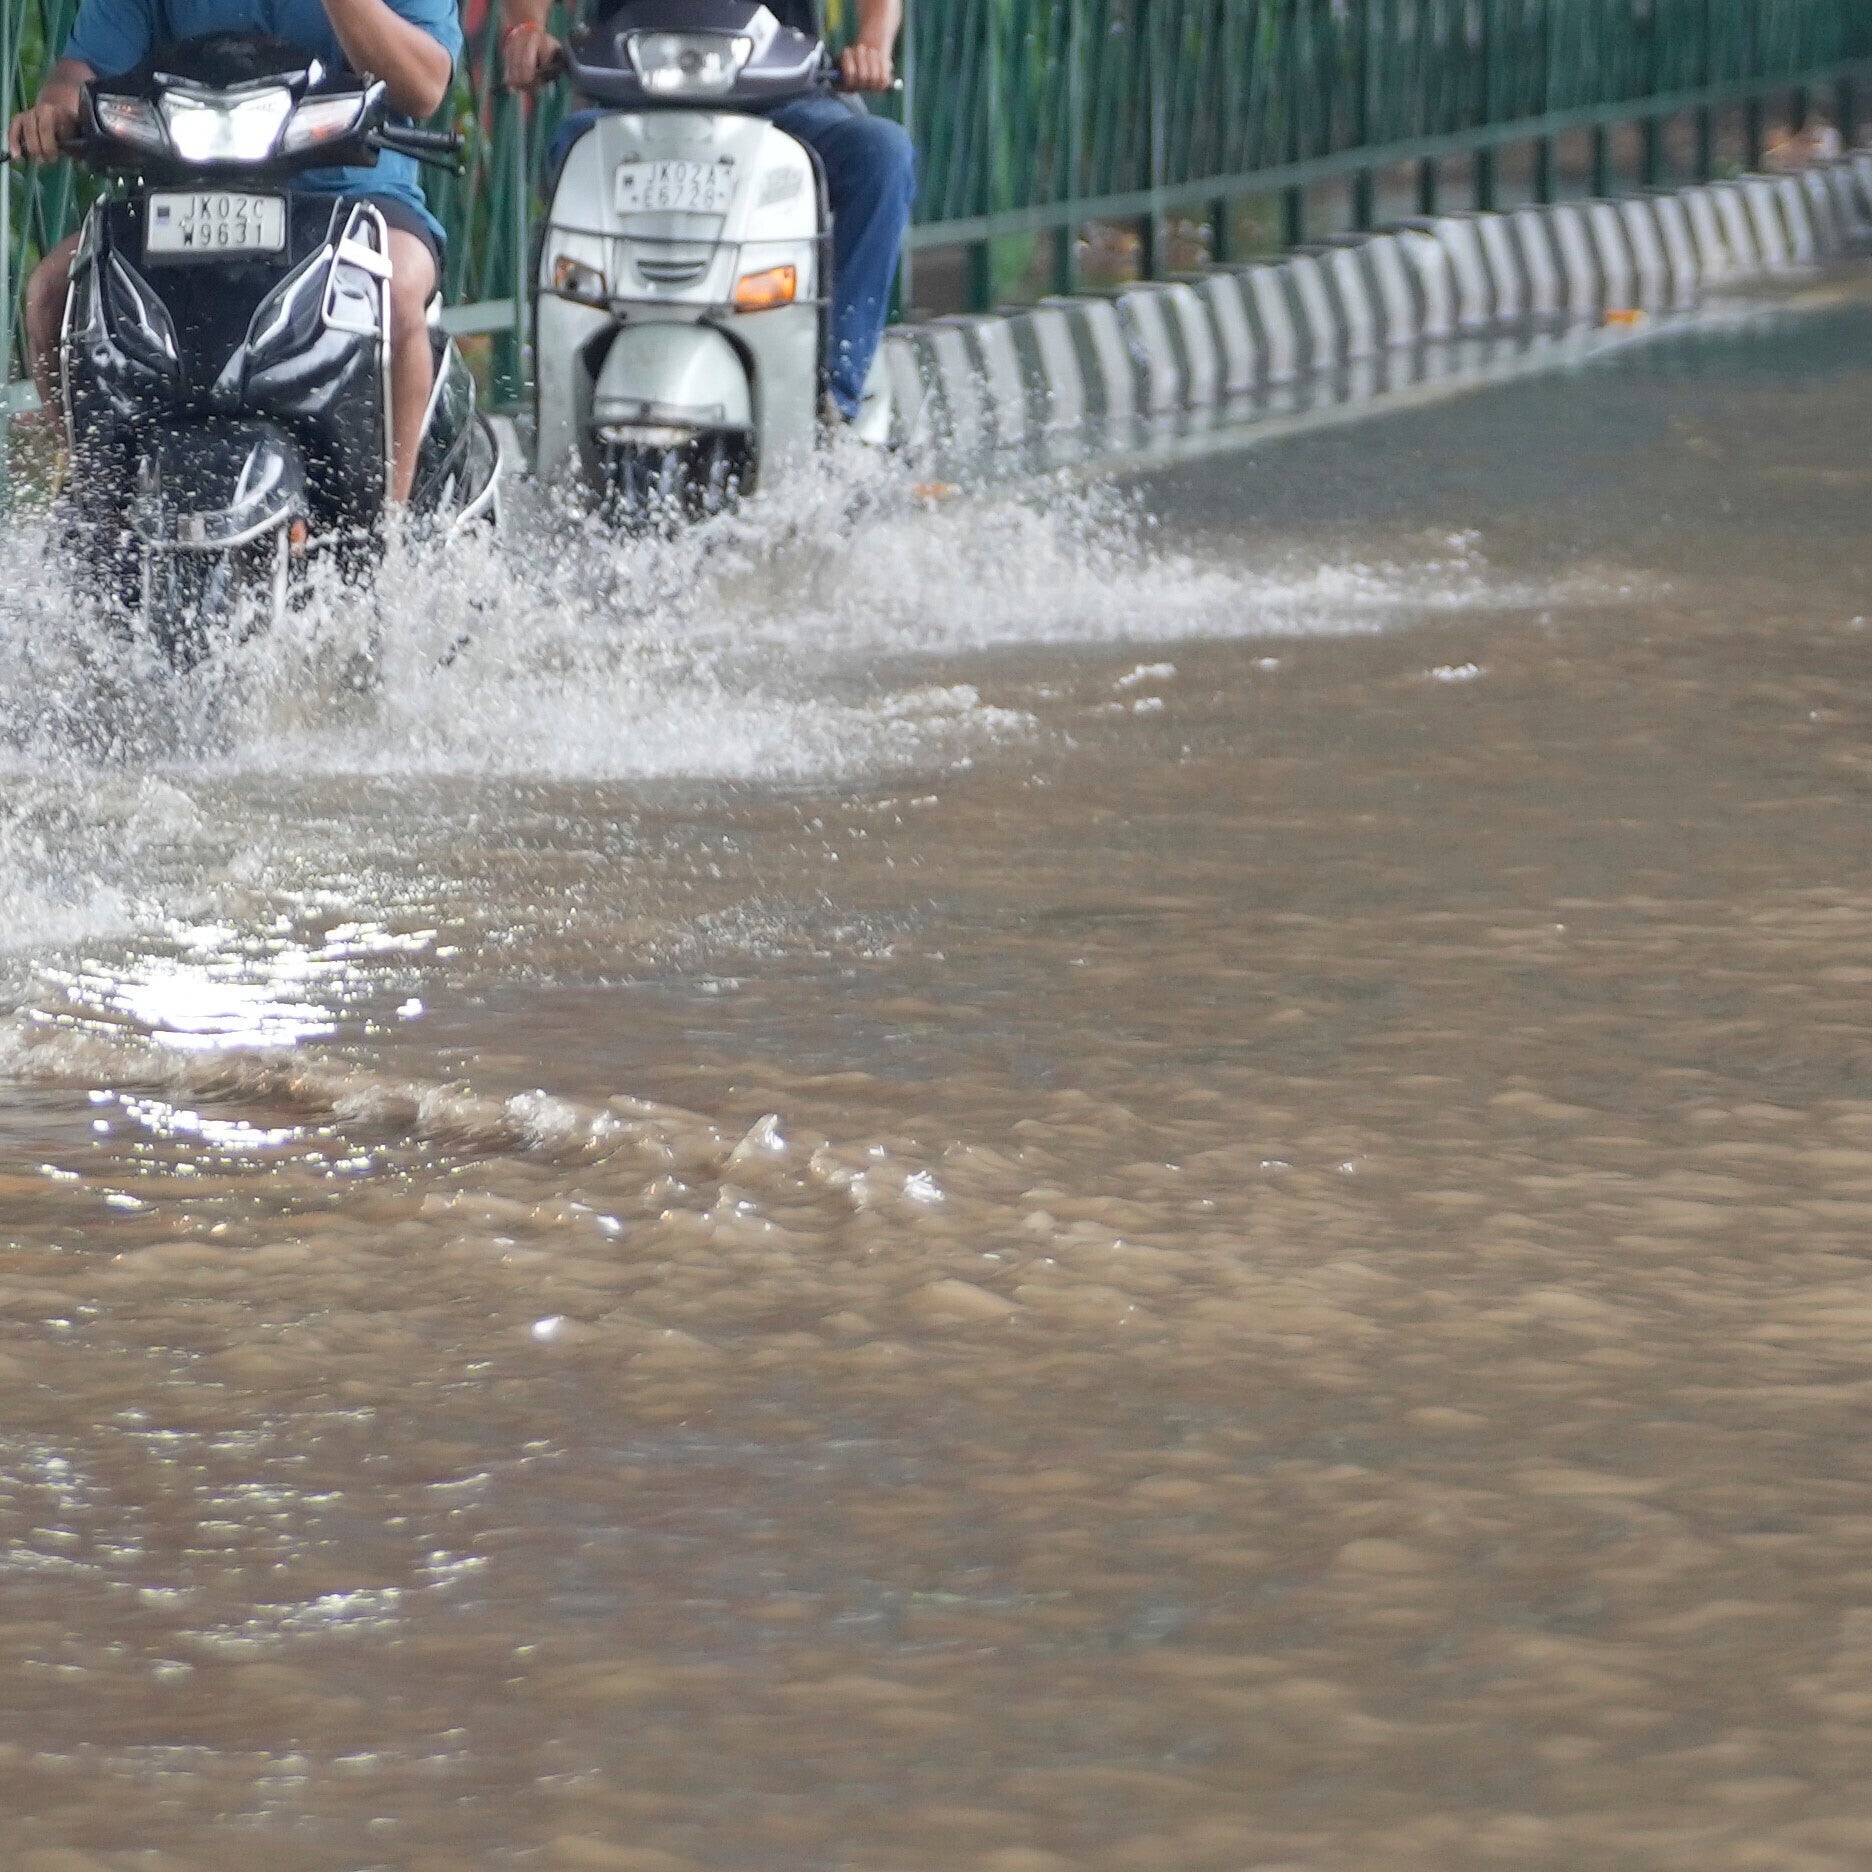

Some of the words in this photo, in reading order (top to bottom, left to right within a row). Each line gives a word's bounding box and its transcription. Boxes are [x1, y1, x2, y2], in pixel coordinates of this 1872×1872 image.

[647, 162, 716, 185] JK02A
[184, 196, 264, 219] JK02C
[181, 219, 262, 246] W9631
